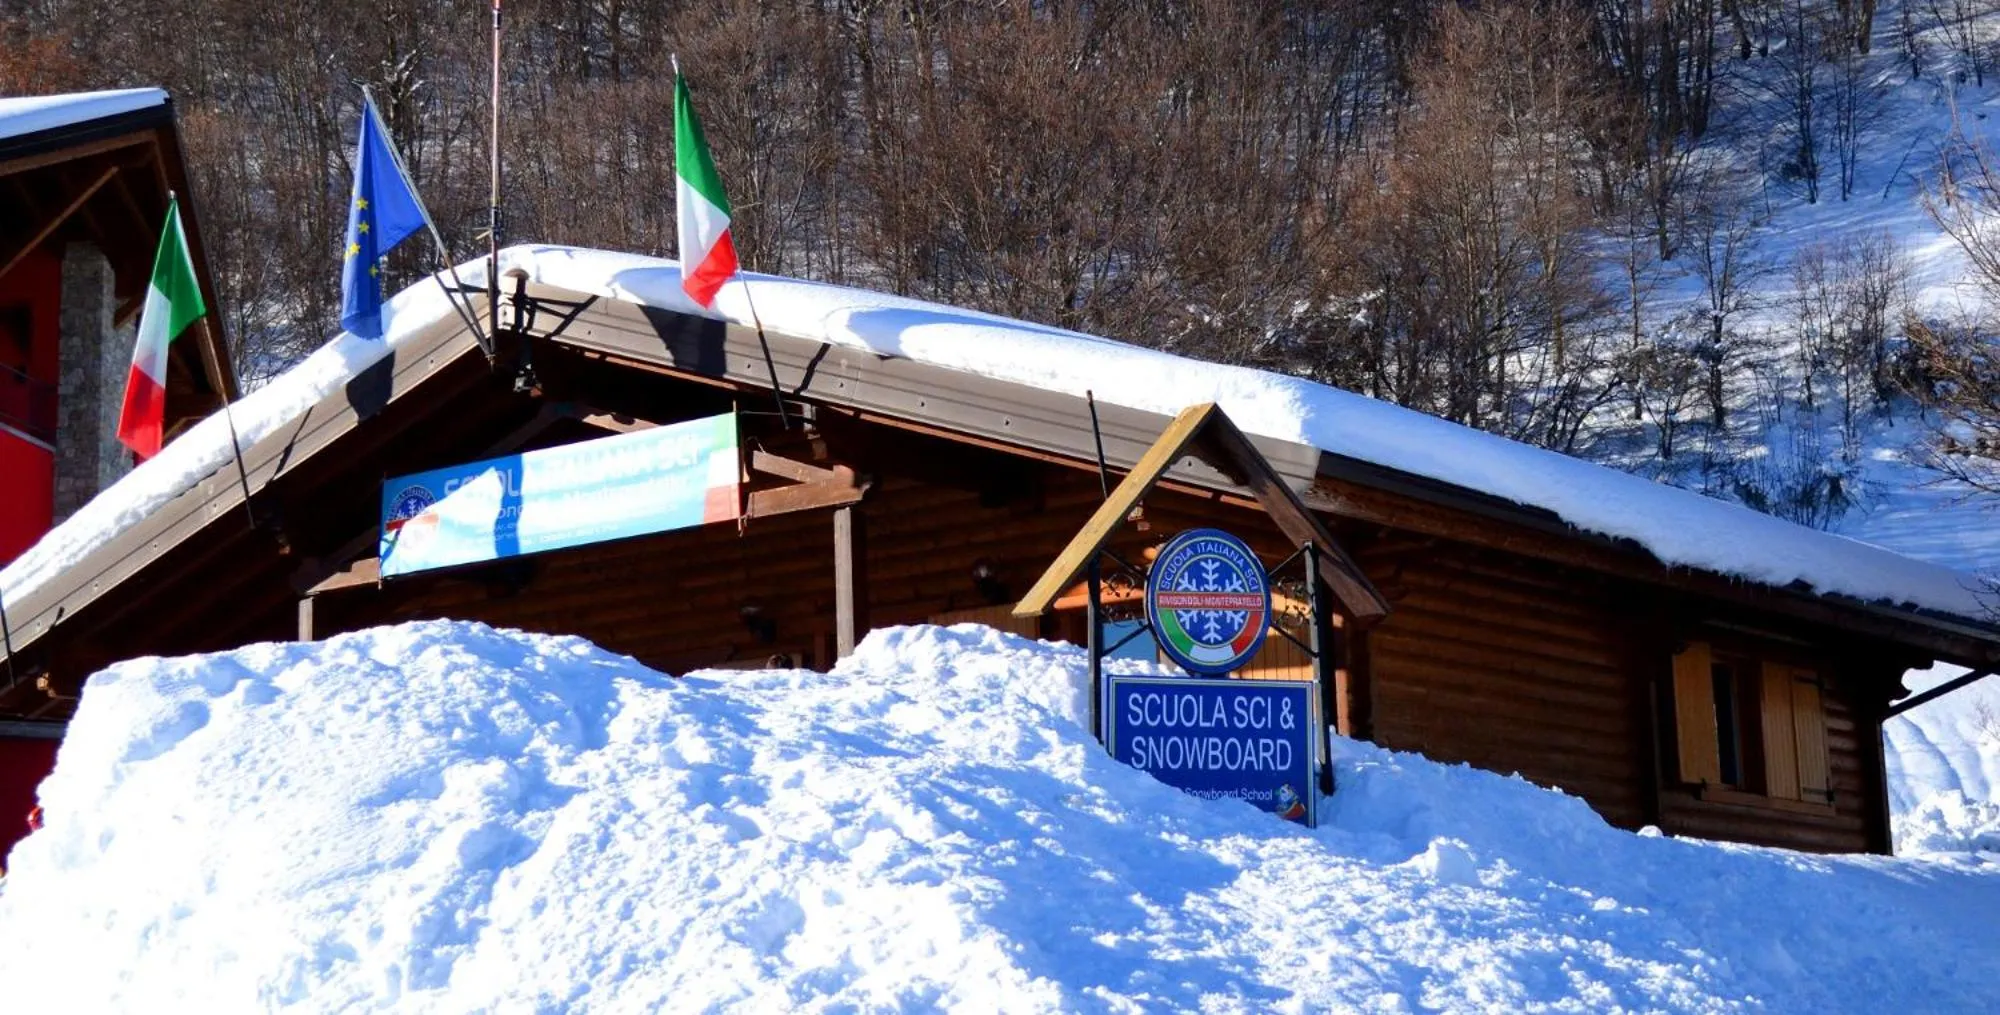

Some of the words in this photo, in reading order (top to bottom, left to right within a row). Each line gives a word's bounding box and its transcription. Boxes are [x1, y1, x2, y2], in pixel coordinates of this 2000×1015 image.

[1161, 547, 1194, 589] SCUOLA
[1197, 542, 1245, 568] ITALIANA
[1244, 569, 1259, 590] SCI
[1128, 693, 1228, 728] SCUOLA
[1234, 696, 1272, 728] SCI
[1280, 697, 1295, 729] &
[1131, 736, 1292, 771] SNOWBOARD
[1184, 787, 1238, 800] Snowboard
[1241, 788, 1272, 801] School
